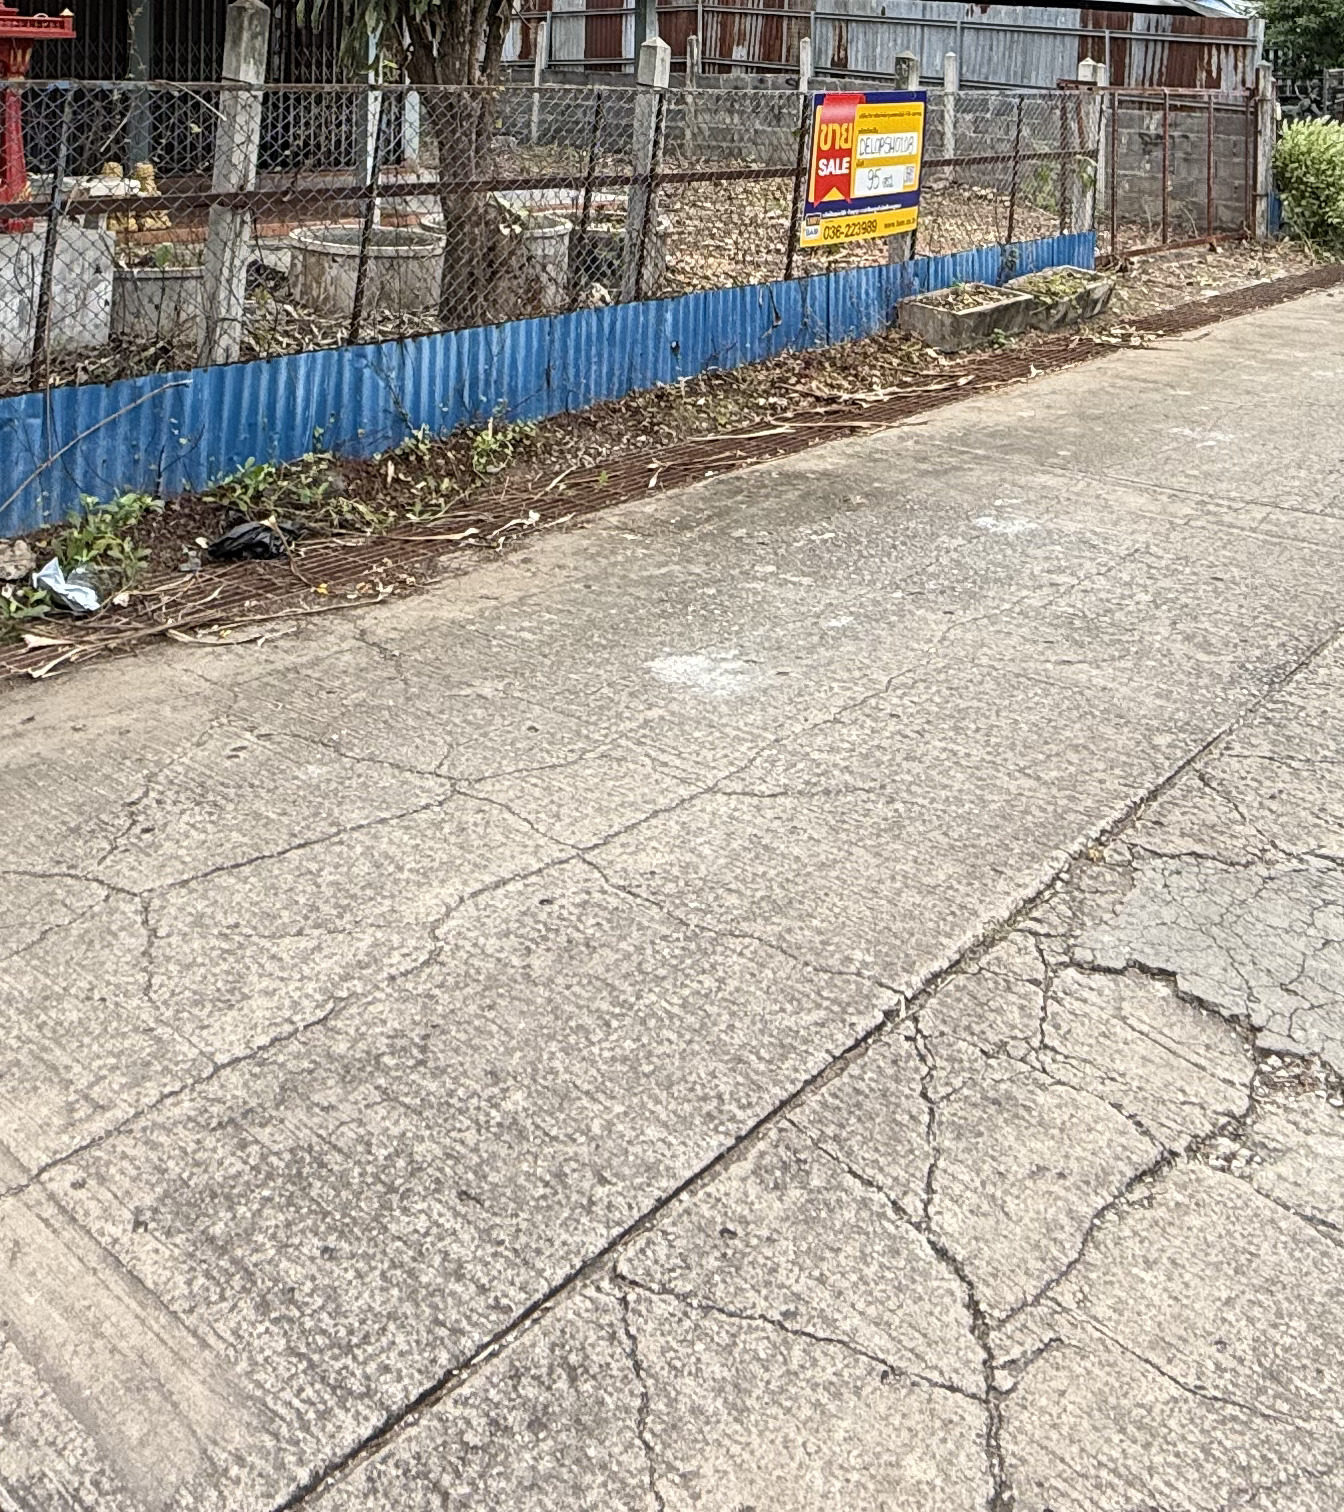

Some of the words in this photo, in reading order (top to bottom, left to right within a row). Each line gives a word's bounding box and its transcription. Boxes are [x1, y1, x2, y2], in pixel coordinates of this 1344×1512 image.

[820, 123, 853, 150] ขาย
[817, 157, 851, 177] SALE
[867, 168, 882, 191] 95
